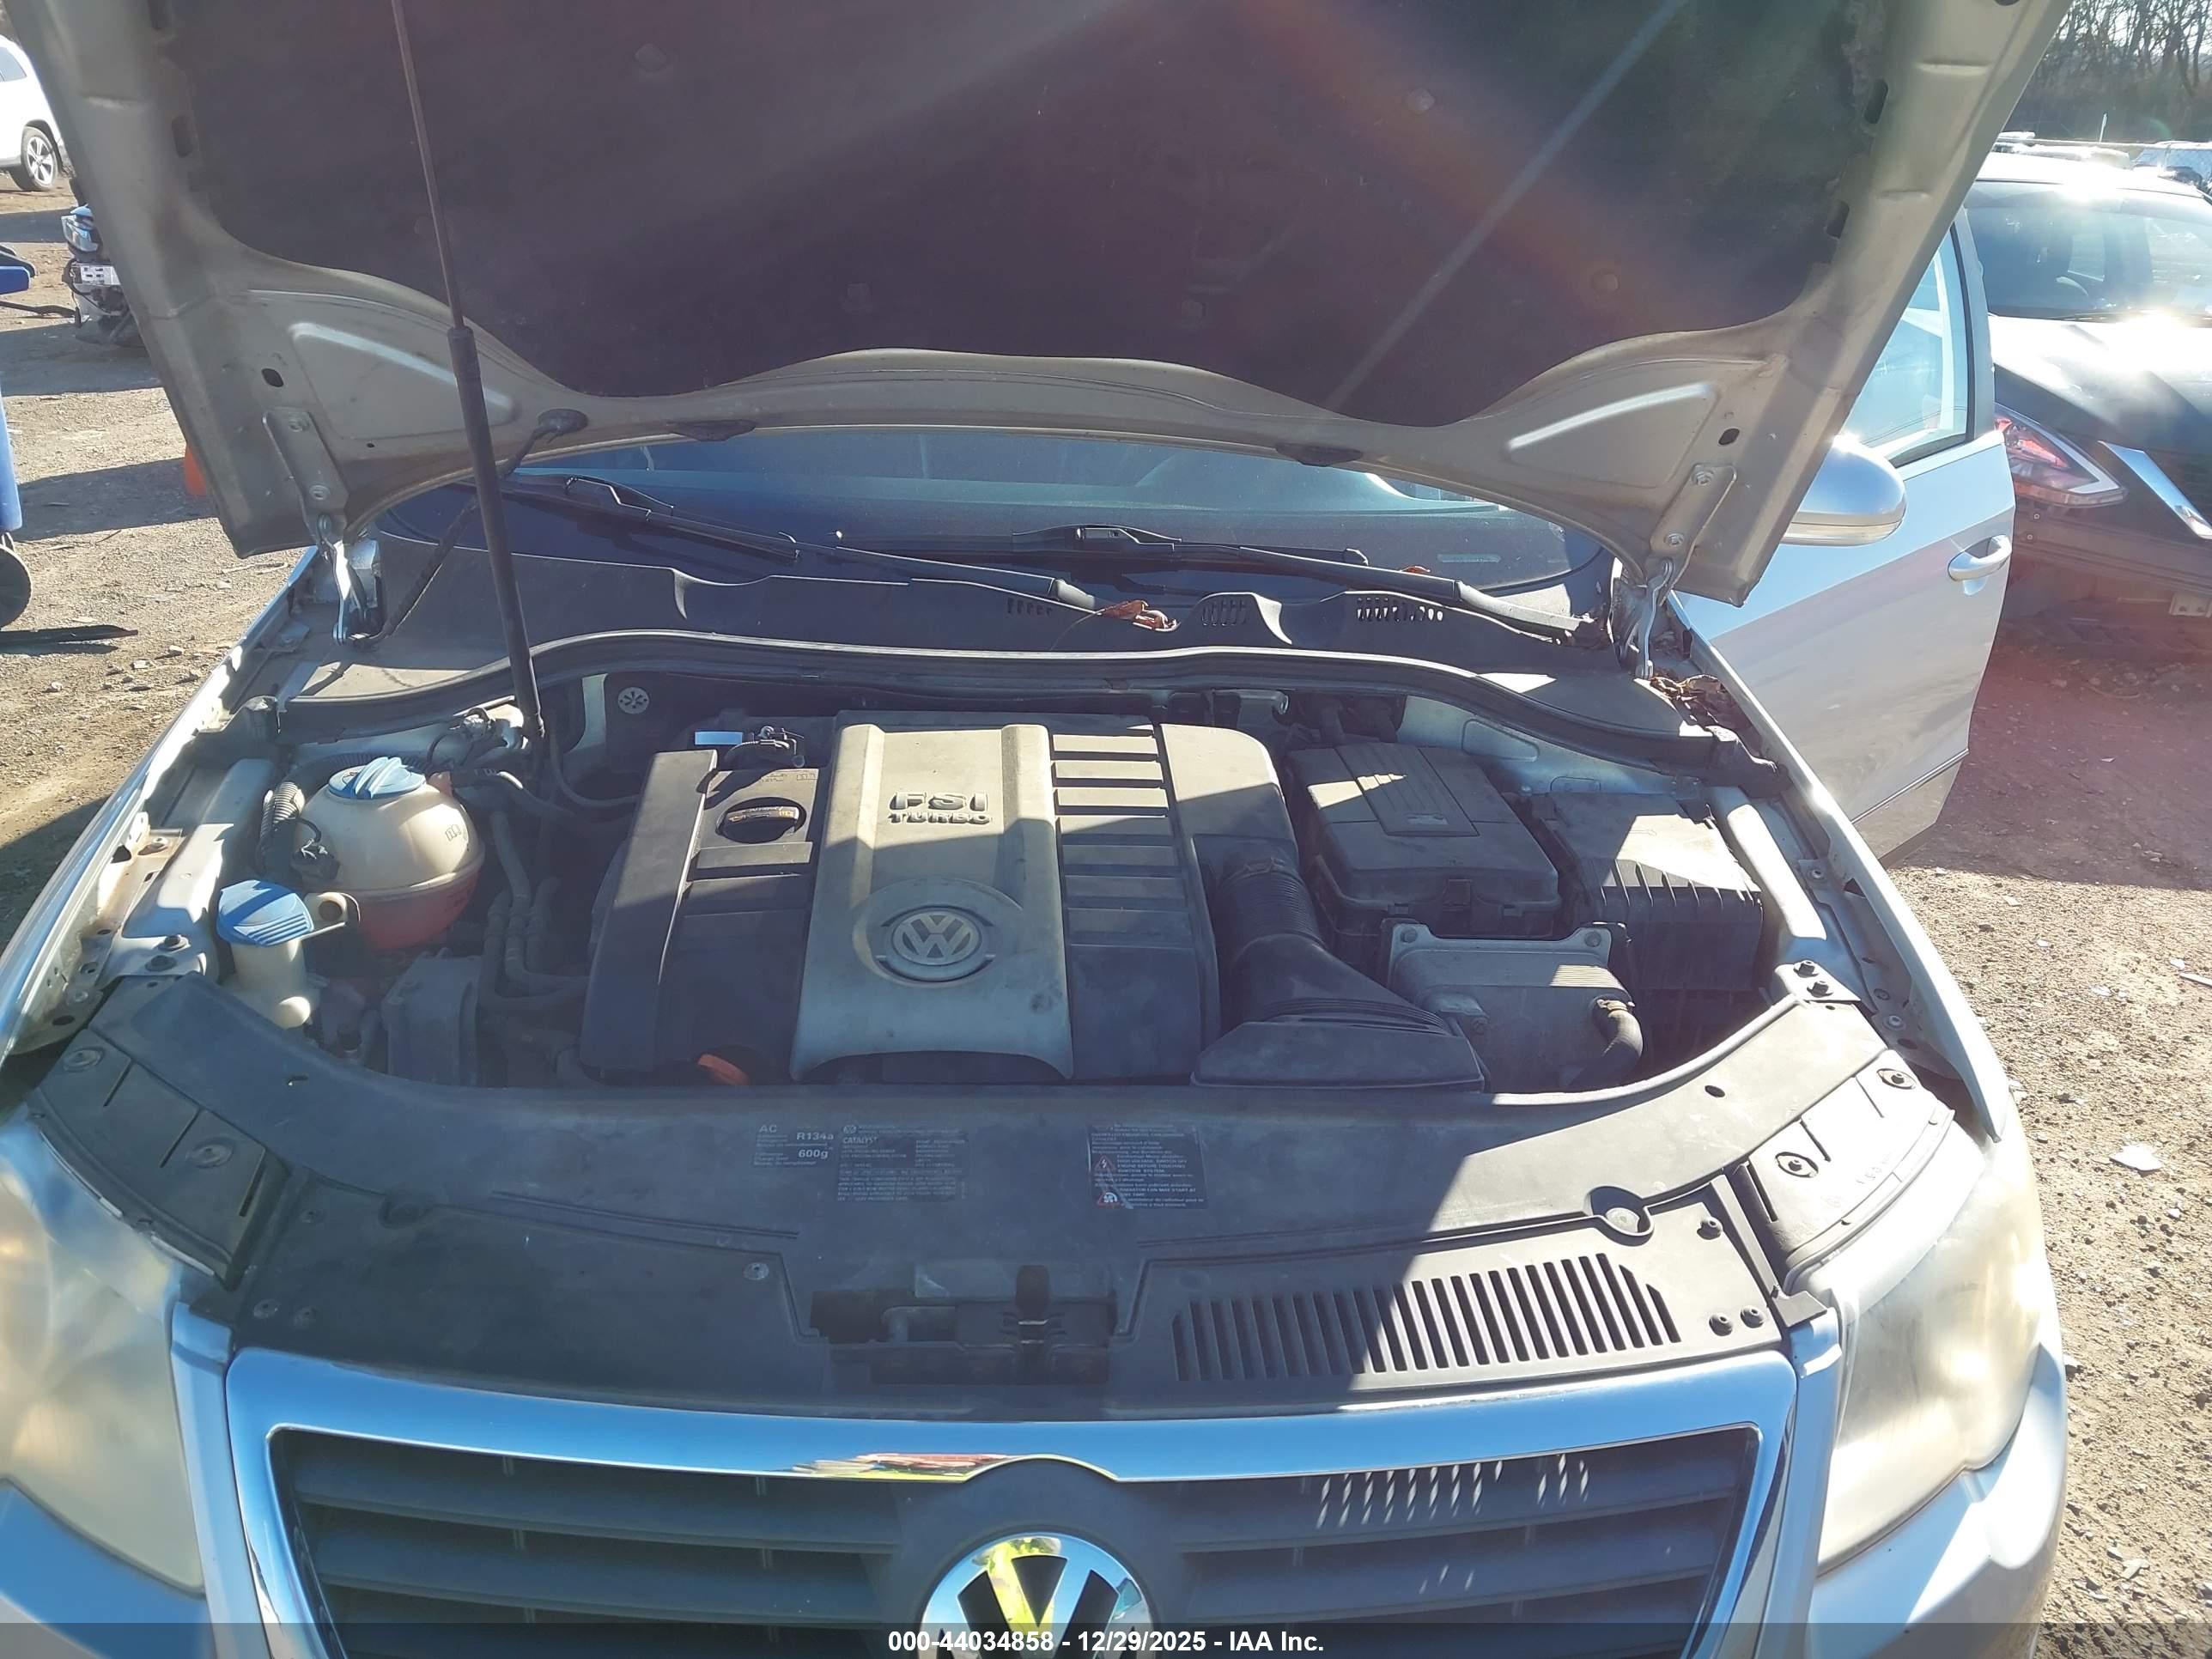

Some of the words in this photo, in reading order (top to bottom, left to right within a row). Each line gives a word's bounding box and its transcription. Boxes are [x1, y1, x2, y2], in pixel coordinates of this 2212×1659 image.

[889, 792, 988, 811] FSI
[888, 811, 990, 824] TURBO
[758, 1123, 778, 1133] AC
[796, 1131, 835, 1141] R134a
[798, 1149, 830, 1160] 600g
